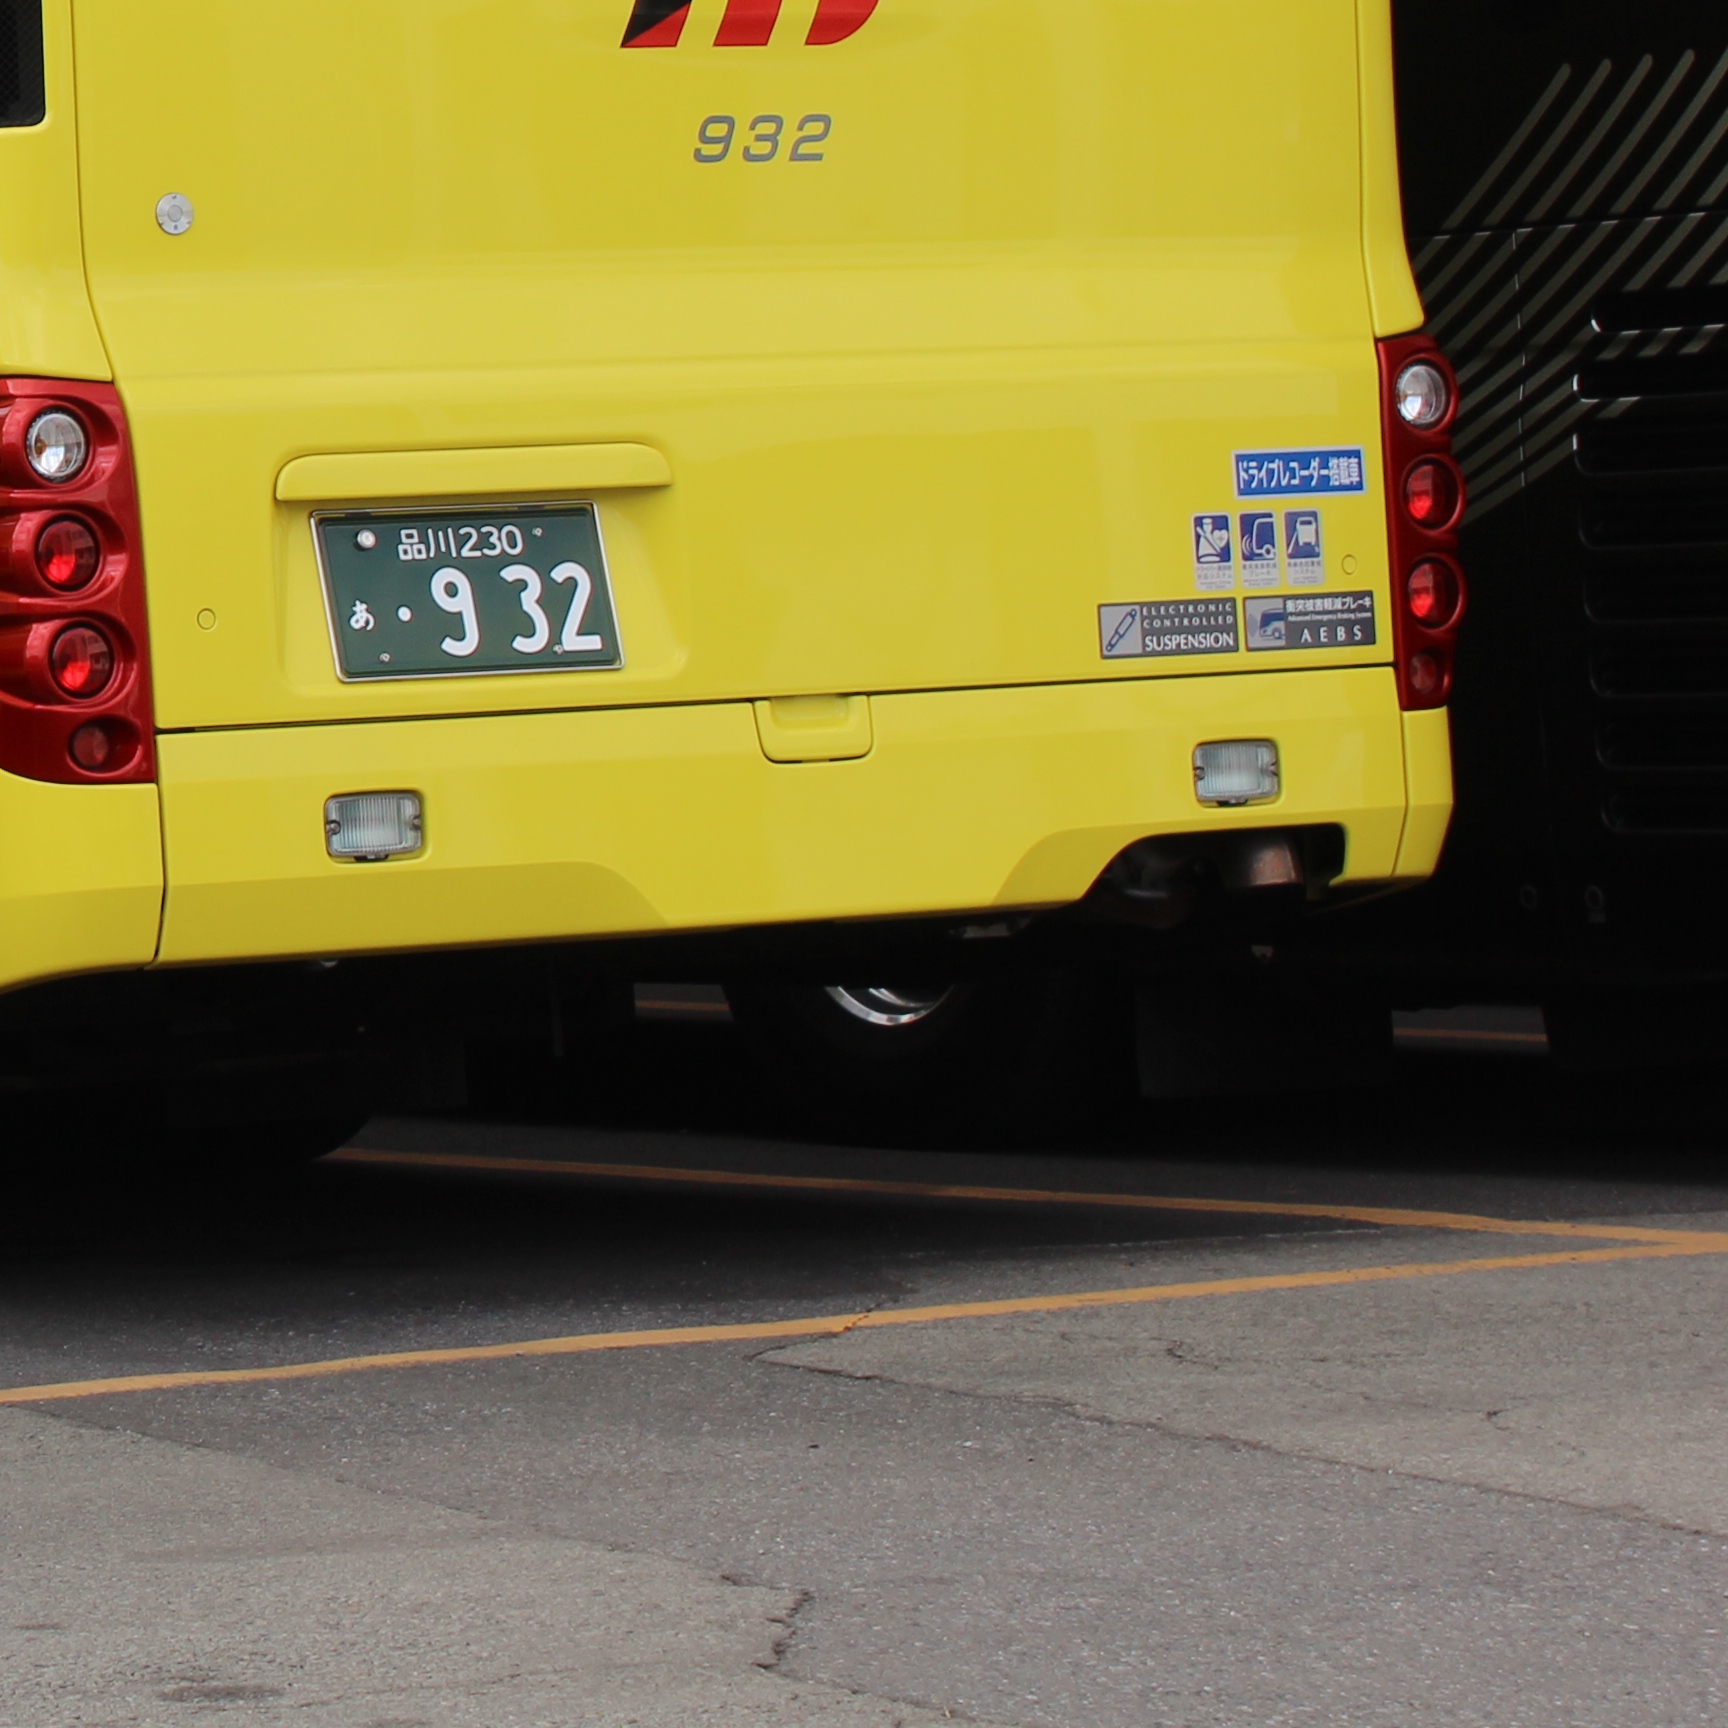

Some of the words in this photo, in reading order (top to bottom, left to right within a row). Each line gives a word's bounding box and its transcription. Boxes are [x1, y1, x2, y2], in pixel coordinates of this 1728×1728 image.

[693, 114, 832, 163] 932
[1238, 457, 1361, 489] ドライブレコーダー搭載車
[349, 599, 376, 632] あ
[1143, 602, 1232, 615] ELECTRONIC
[1143, 615, 1233, 628] CONTROLLED
[1145, 632, 1234, 651] SUSPENSION
